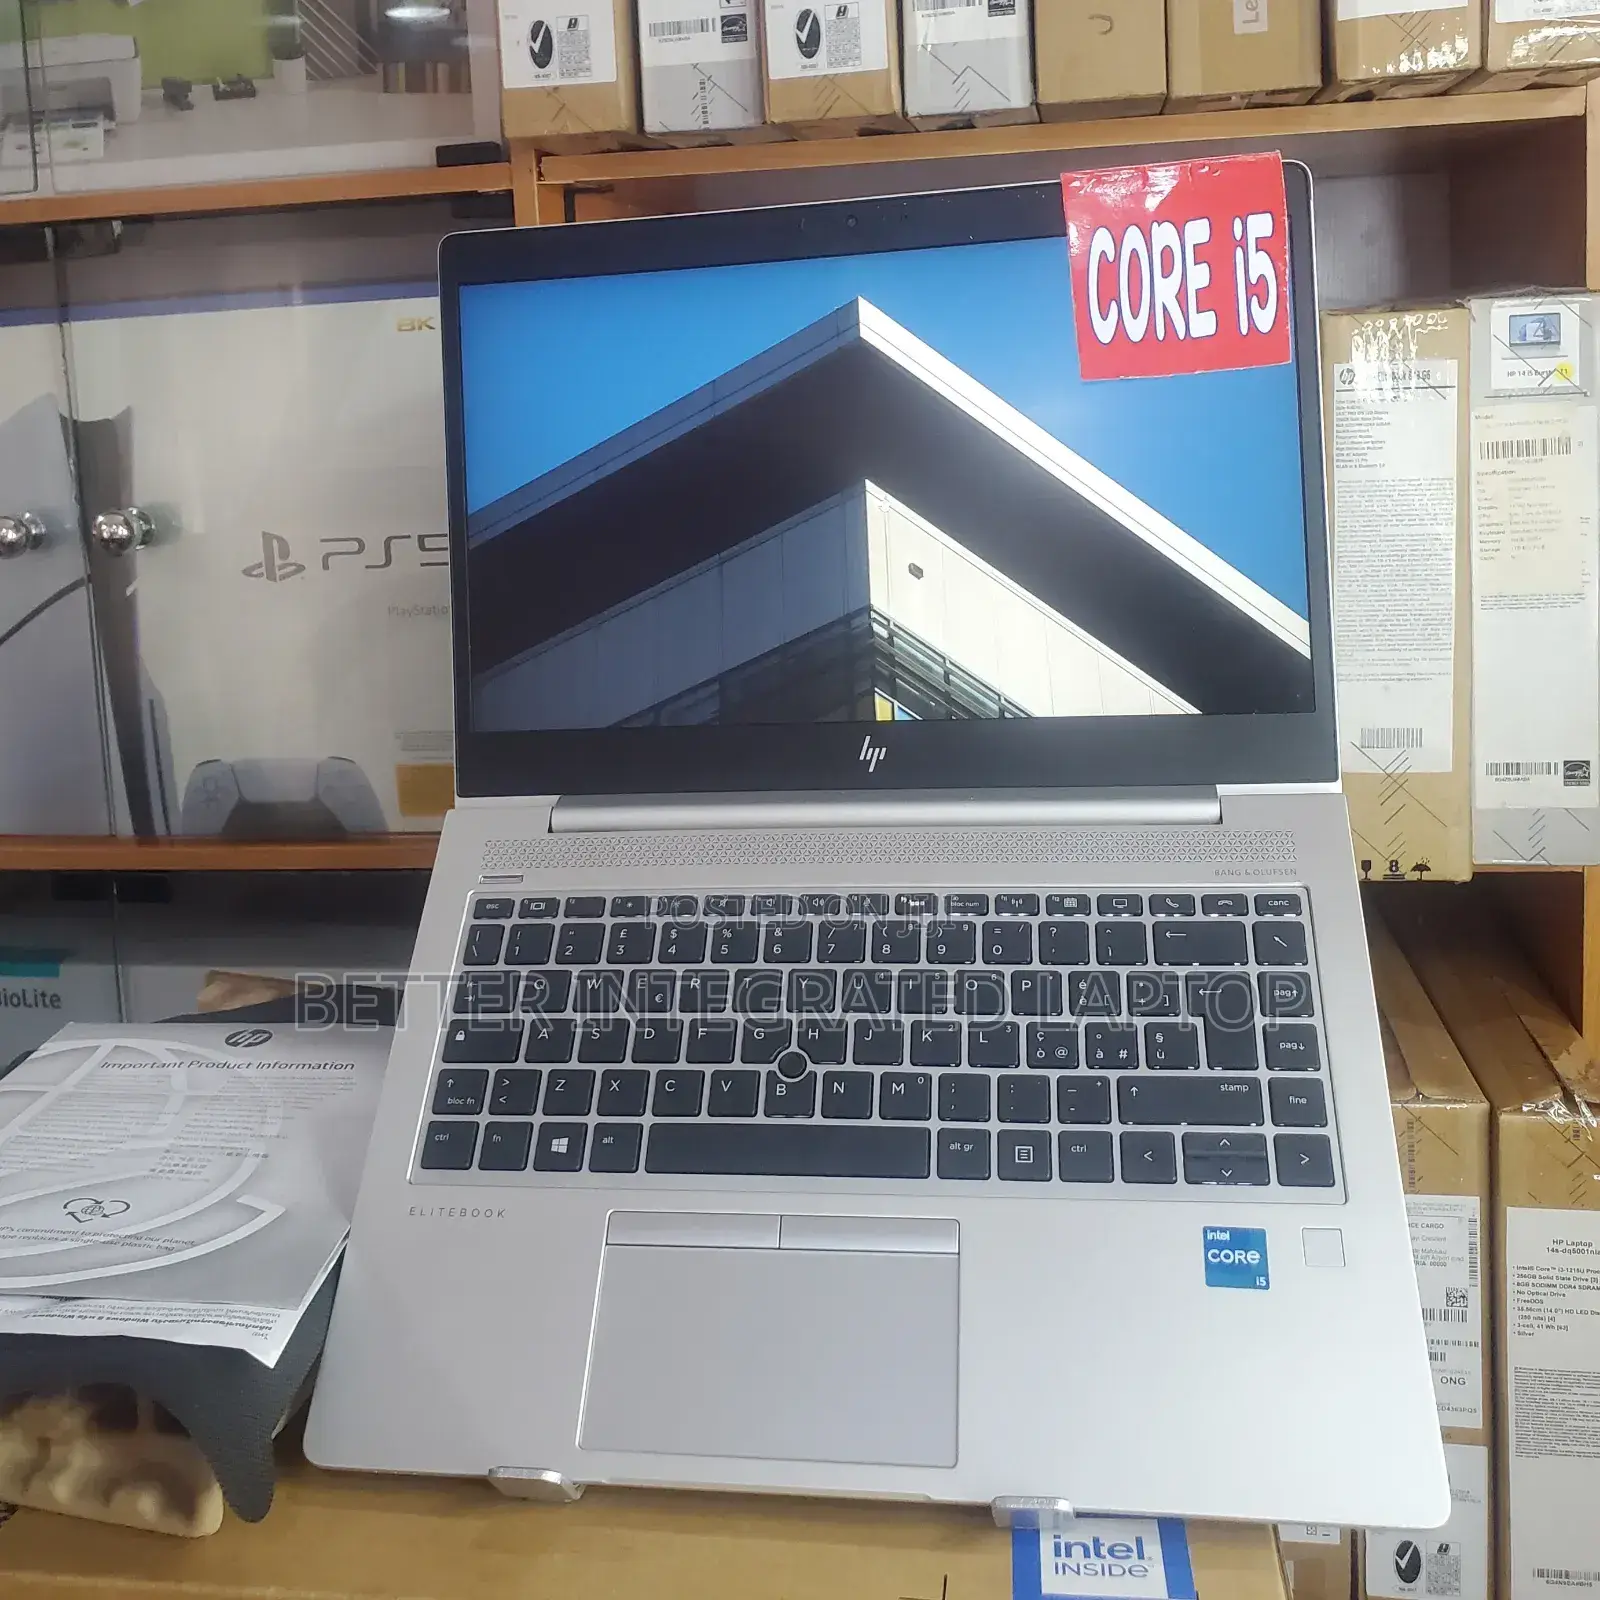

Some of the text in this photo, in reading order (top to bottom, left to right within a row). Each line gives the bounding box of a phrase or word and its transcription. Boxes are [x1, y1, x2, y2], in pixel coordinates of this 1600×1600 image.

[1088, 212, 1278, 344] CORE i5
[396, 316, 435, 331] 8K
[320, 533, 450, 571] PS5
[388, 604, 450, 617] PlayStatio
[514, 946, 520, 956] 1
[565, 946, 574, 956] 2
[616, 945, 624, 956] 3
[668, 945, 676, 954] 4
[720, 944, 728, 954] 5
[774, 944, 782, 954] 6
[828, 944, 836, 954] 7
[882, 944, 890, 954] 8
[937, 944, 946, 954] 9
[534, 978, 546, 991] Q
[587, 978, 602, 990] W
[637, 978, 648, 989] E
[690, 978, 700, 989] R
[744, 978, 754, 989] T
[799, 978, 810, 989] Y
[854, 978, 864, 990] U
[965, 980, 978, 990] O
[1022, 980, 1032, 992] P
[1273, 988, 1292, 998] pag
[0, 988, 62, 1010] ioLite
[538, 1028, 550, 1040] A
[591, 1028, 600, 1040] S
[644, 1028, 655, 1040] D
[698, 1028, 708, 1039] F
[754, 1028, 764, 1040] G
[808, 1029, 819, 1040] H
[864, 1030, 872, 1041] J
[922, 1030, 932, 1042] K
[979, 1031, 988, 1042] L
[1054, 1046, 1068, 1058] @
[1279, 1042, 1298, 1051] pag
[1036, 1048, 1046, 1058] ò
[1096, 1048, 1104, 1059] à
[1156, 1048, 1165, 1059] ù
[100, 1060, 355, 1070] Important Product Information
[554, 1080, 566, 1092] Z
[608, 1080, 620, 1092] X
[664, 1080, 676, 1092] C
[721, 1081, 732, 1092] V
[776, 1084, 787, 1096] B
[834, 1082, 844, 1094] N
[892, 1082, 904, 1095] M
[1220, 1083, 1249, 1093] stamp
[447, 1096, 475, 1106] bloc fn
[1289, 1096, 1307, 1104] fine
[434, 1132, 450, 1142] ctrl
[492, 1134, 502, 1143] fn
[602, 1136, 614, 1144] alt
[950, 1142, 974, 1152] alt gr
[1071, 1144, 1086, 1153] ctrl
[409, 1206, 506, 1218] ELITEBOOK
[16, 1228, 79, 1236] commitment
[1207, 1230, 1230, 1241] intel
[1566, 1240, 1593, 1248] Laptop
[1256, 1276, 1267, 1286] i5
[1440, 1376, 1466, 1386] ONG
